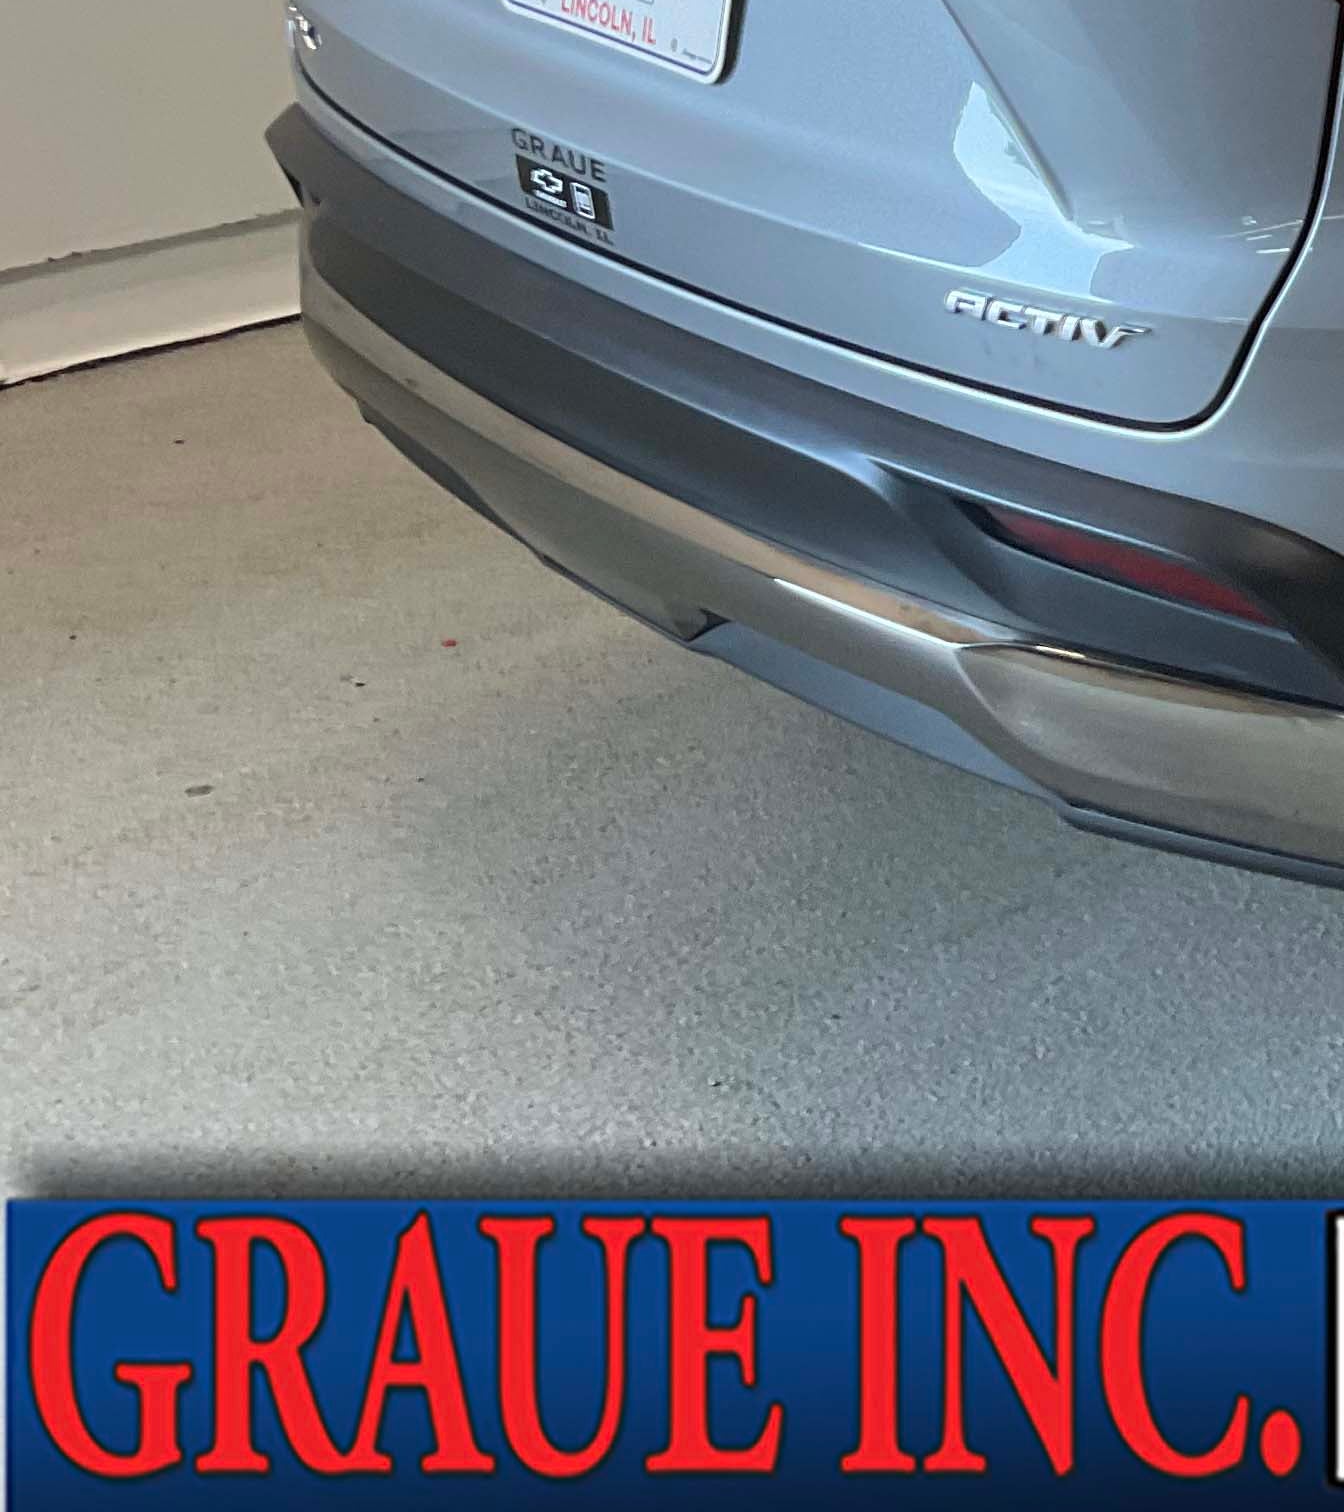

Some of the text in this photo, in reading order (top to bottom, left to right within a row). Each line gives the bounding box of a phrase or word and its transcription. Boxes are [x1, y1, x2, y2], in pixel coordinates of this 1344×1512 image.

[641, 16, 656, 44] IL
[512, 129, 607, 183] GRAUE
[945, 288, 1151, 348] ACTIV
